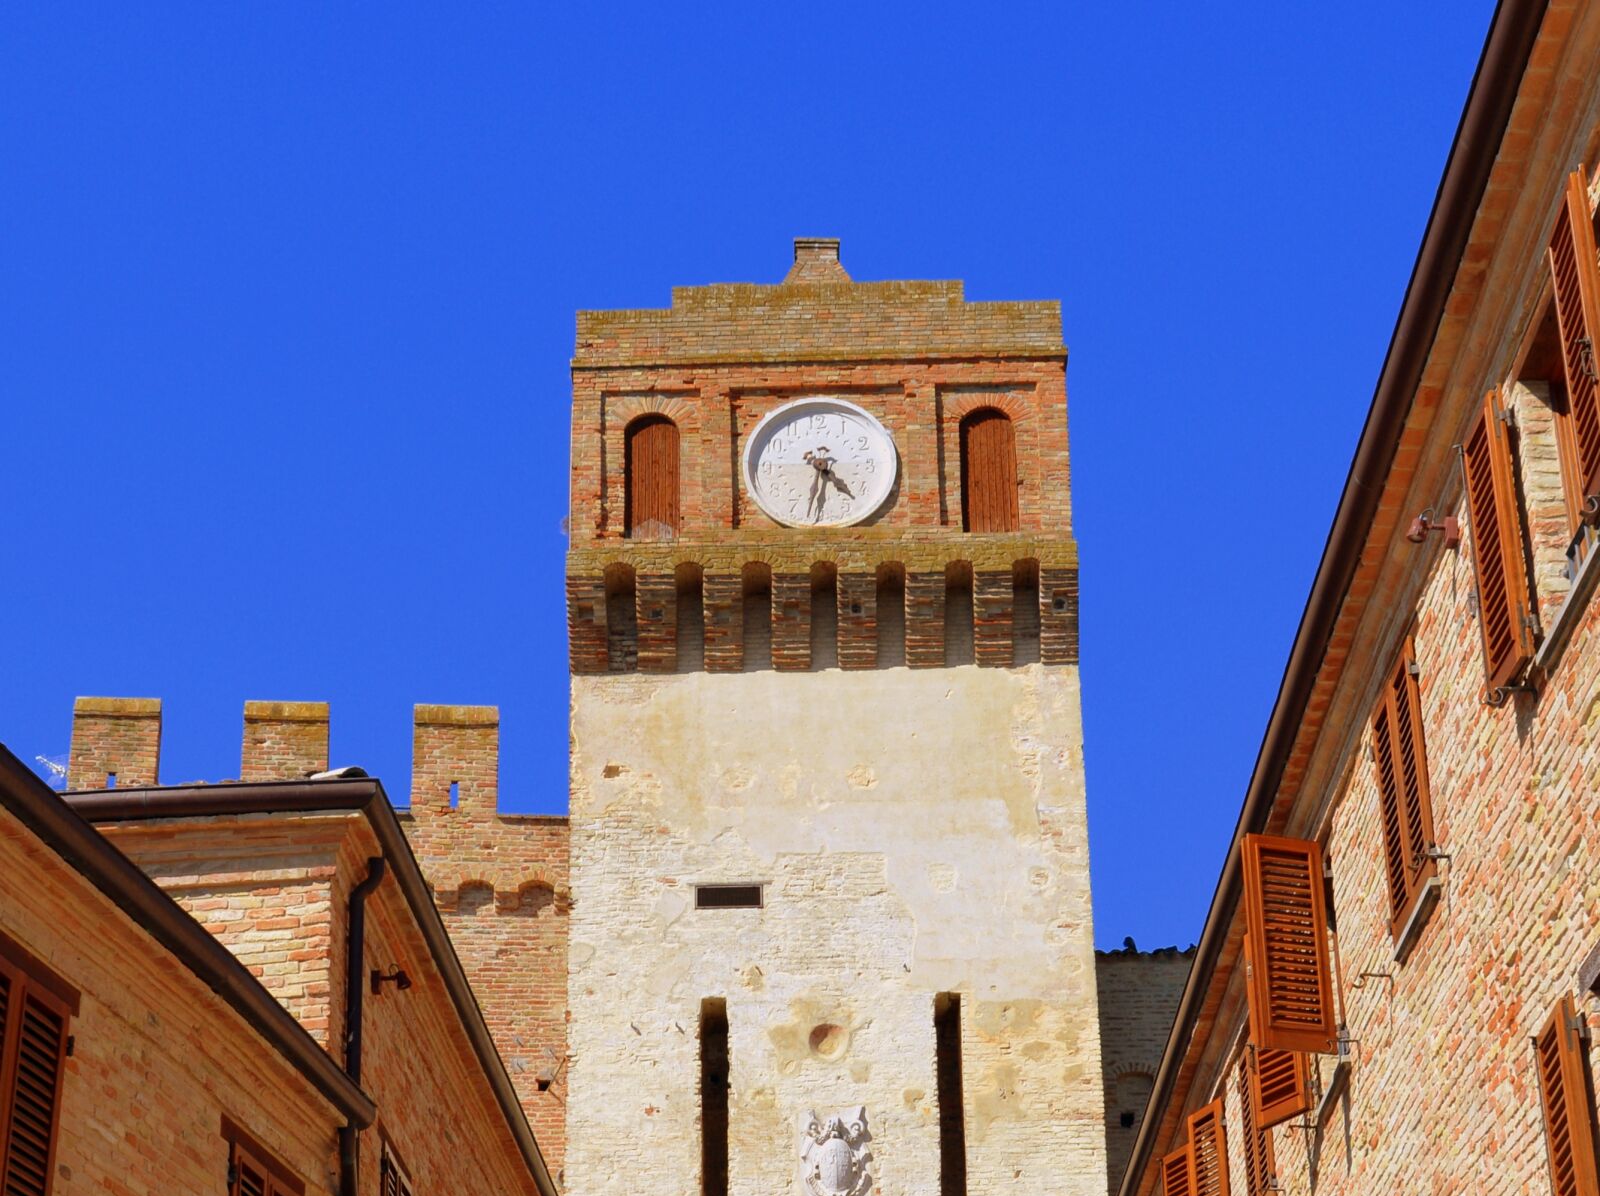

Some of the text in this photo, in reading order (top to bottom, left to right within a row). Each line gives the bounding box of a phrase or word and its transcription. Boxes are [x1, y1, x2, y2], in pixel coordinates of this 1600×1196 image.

[787, 420, 798, 436] 11
[810, 415, 827, 430] 12
[767, 438, 783, 453] 10
[858, 436, 870, 451] 2
[762, 460, 773, 475] 9
[866, 459, 875, 473] 3
[770, 482, 781, 498] 8
[860, 480, 869, 497] 4
[788, 498, 800, 513] 7
[841, 498, 850, 513] 5
